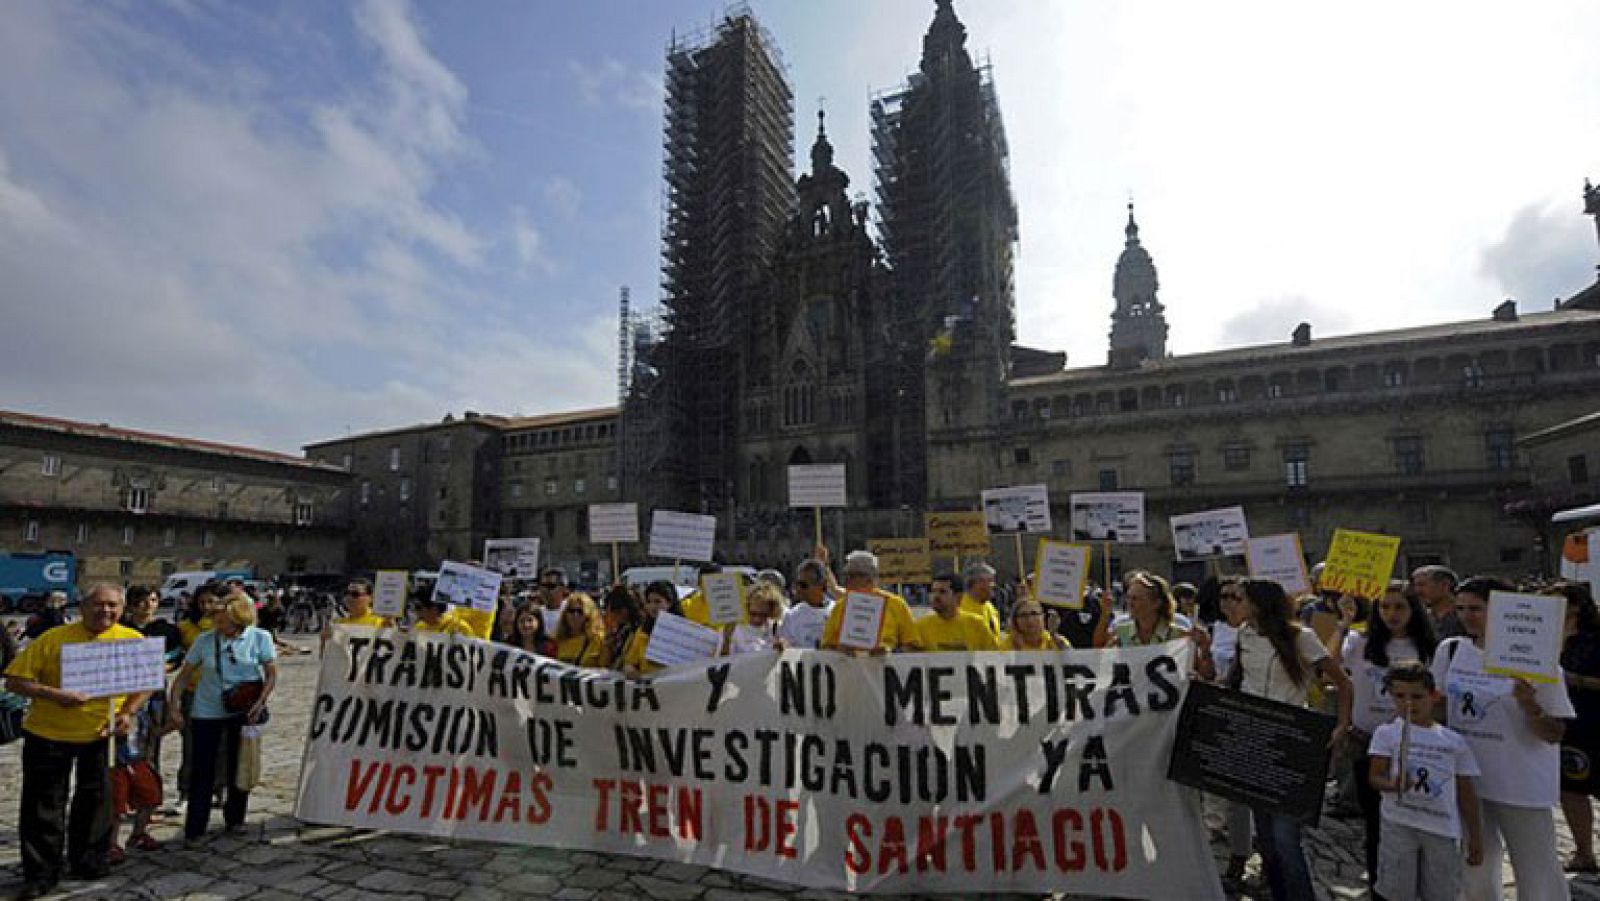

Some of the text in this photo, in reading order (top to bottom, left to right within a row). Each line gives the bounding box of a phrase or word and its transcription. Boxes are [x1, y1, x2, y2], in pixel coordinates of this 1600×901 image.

[44, 562, 69, 583] G
[348, 636, 661, 713] TRANSPARENCIA
[707, 662, 730, 713] Y
[780, 660, 837, 719] NO
[883, 655, 1181, 727] MENTIRAS
[311, 693, 1114, 804] COMISION DE INVESTIGACION YA
[343, 759, 1129, 875] VICTIMAS TREN DE SANTIAGO
